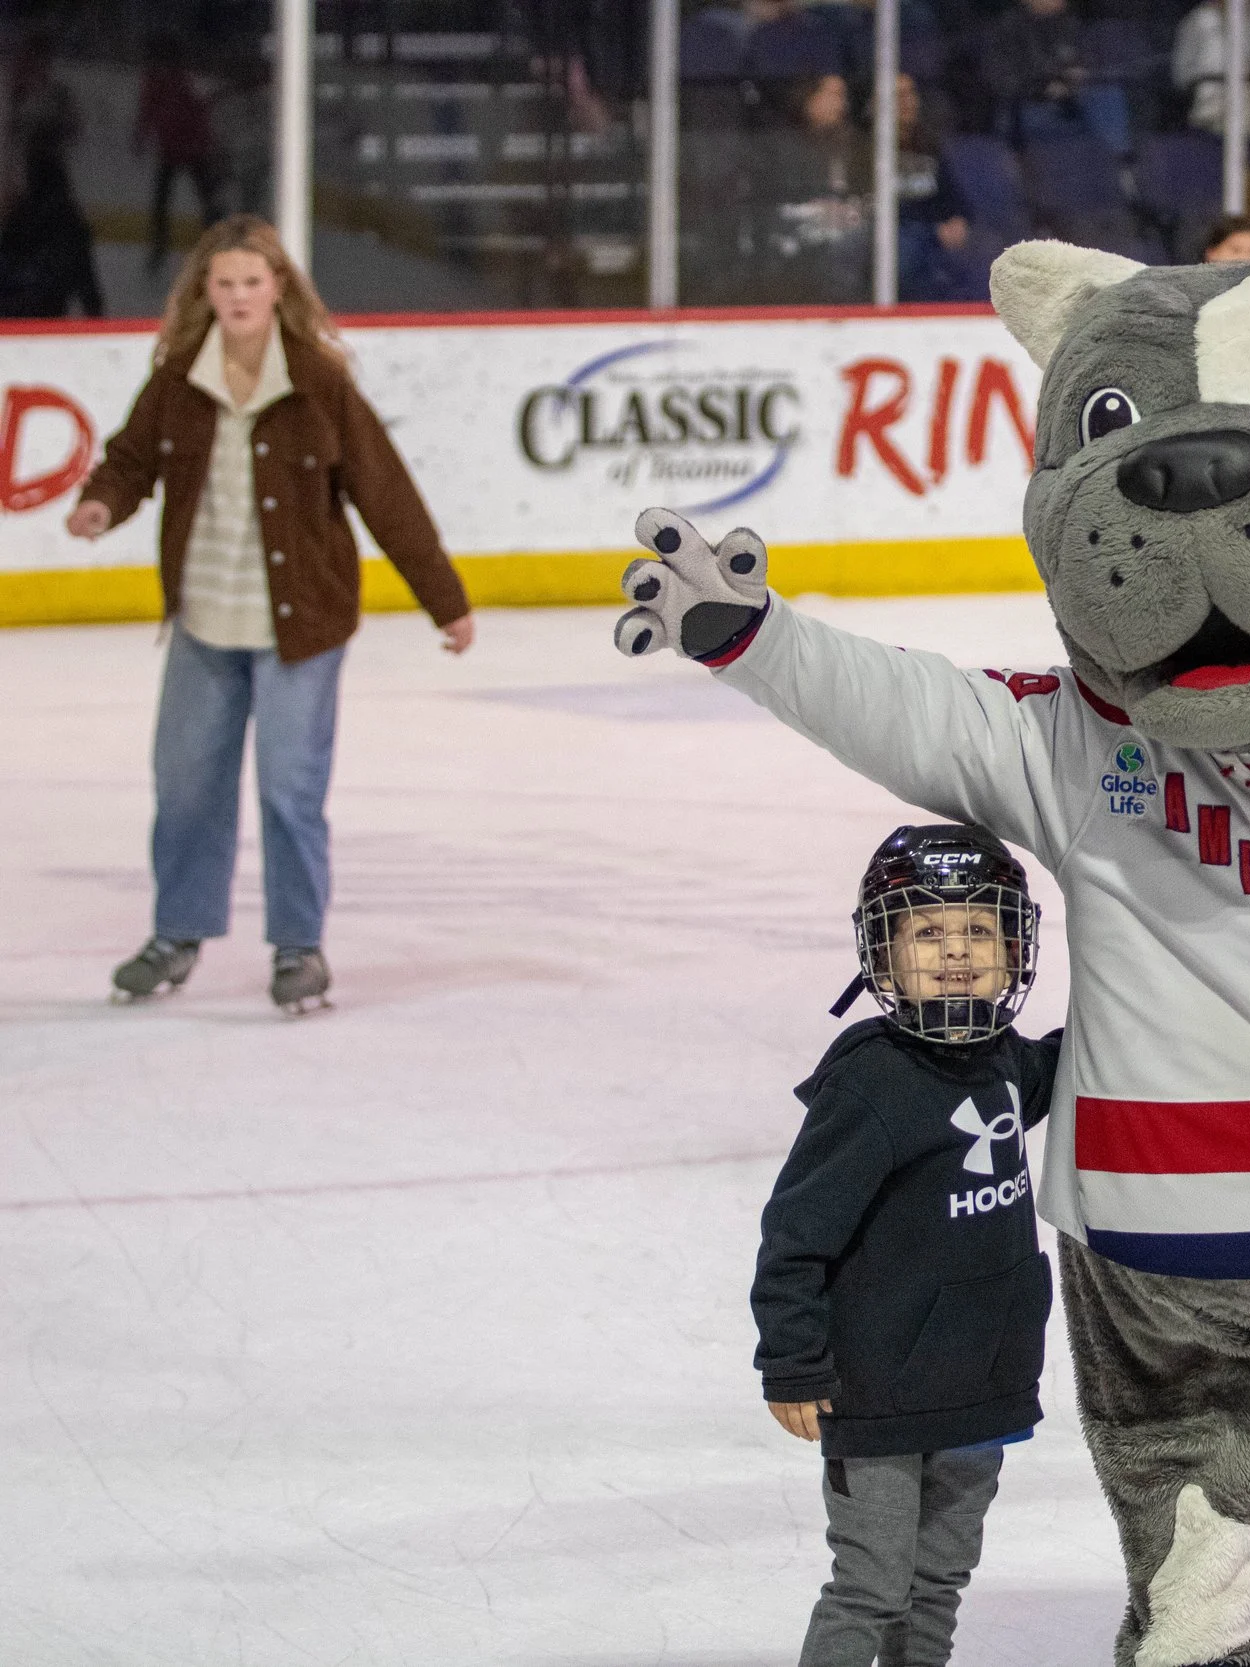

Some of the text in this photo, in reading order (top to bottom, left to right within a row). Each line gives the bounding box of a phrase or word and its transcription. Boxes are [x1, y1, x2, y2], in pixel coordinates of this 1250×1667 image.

[517, 383, 801, 473] CLASSIC
[836, 356, 1036, 498] RIN
[1101, 773, 1158, 797] Globe
[1109, 795, 1146, 816] Life
[923, 853, 981, 865] CCM
